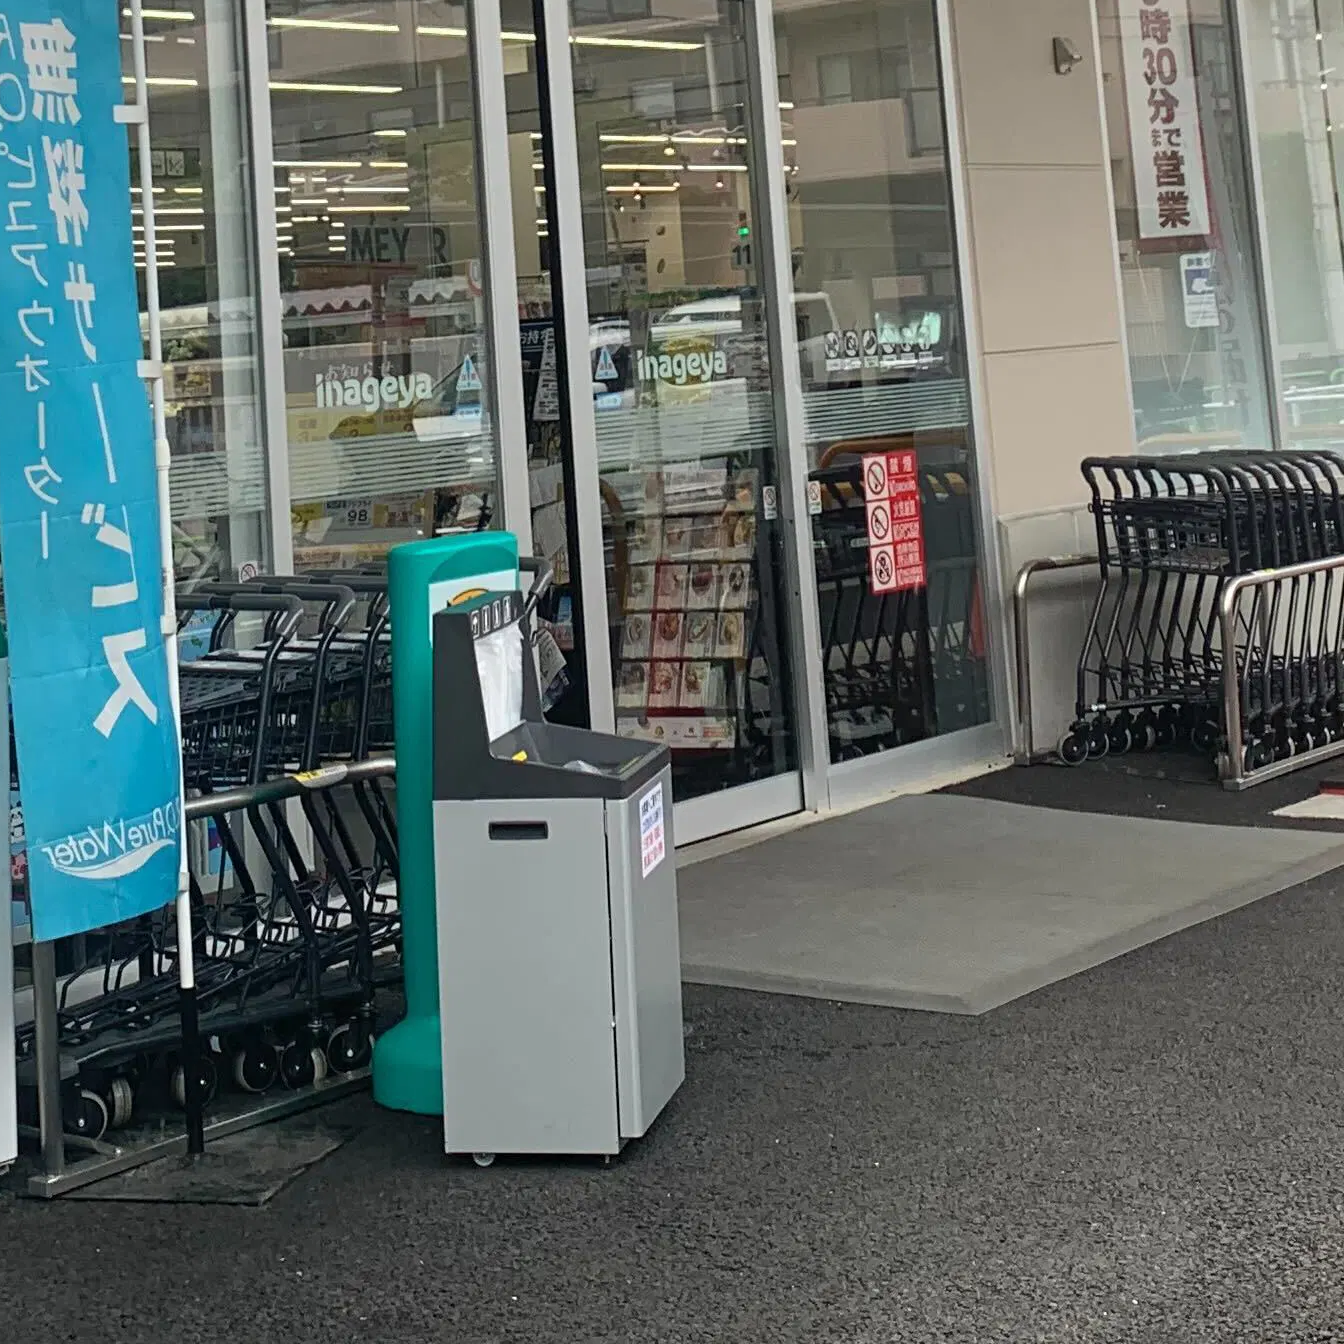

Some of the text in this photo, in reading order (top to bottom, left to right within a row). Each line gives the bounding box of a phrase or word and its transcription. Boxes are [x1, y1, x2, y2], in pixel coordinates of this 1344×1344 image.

[732, 243, 751, 266] 11
[637, 349, 728, 385] inageya
[314, 371, 434, 412] inageya
[347, 509, 368, 522] 98
